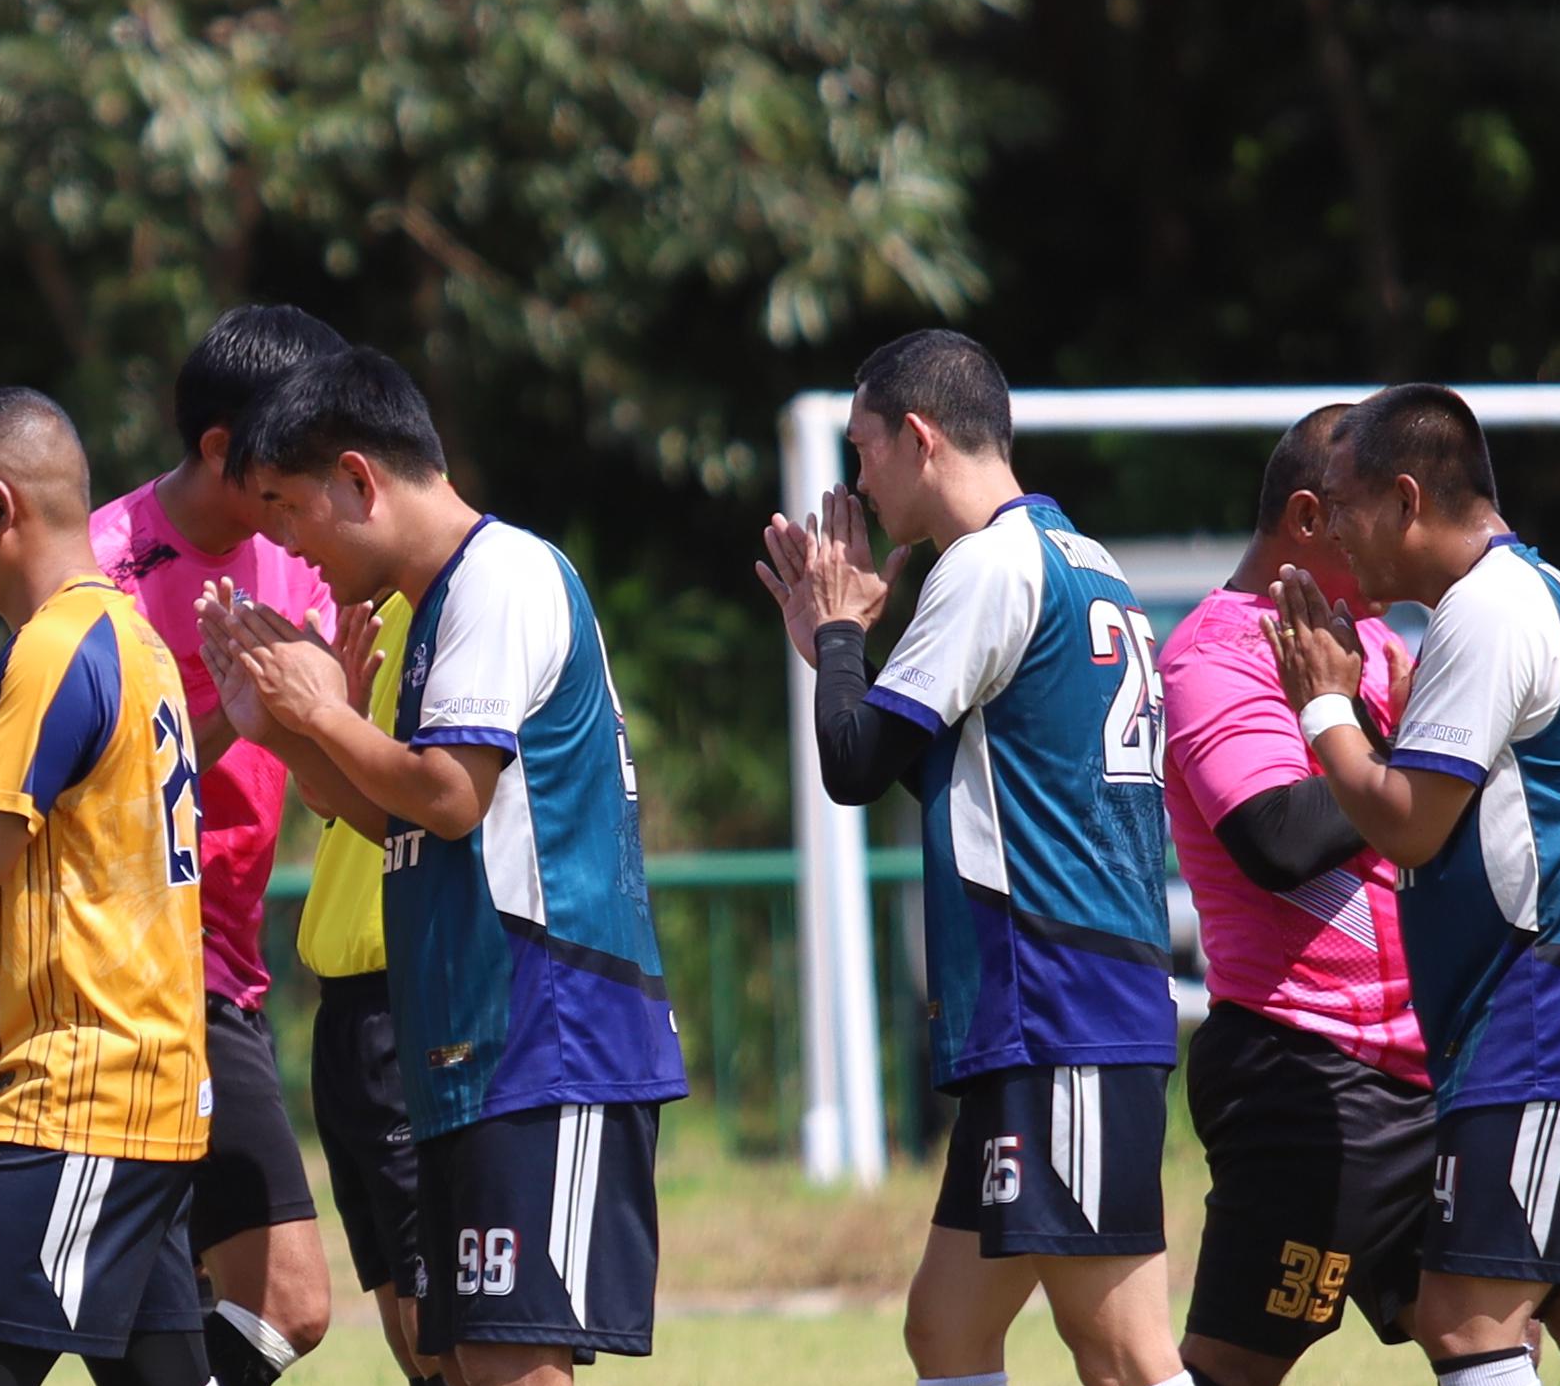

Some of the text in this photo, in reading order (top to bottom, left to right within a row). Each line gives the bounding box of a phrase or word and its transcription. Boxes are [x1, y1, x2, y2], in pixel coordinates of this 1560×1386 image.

[982, 1136, 1021, 1206] 25
[457, 1227, 516, 1295] 98
[1266, 1240, 1351, 1323] 39
